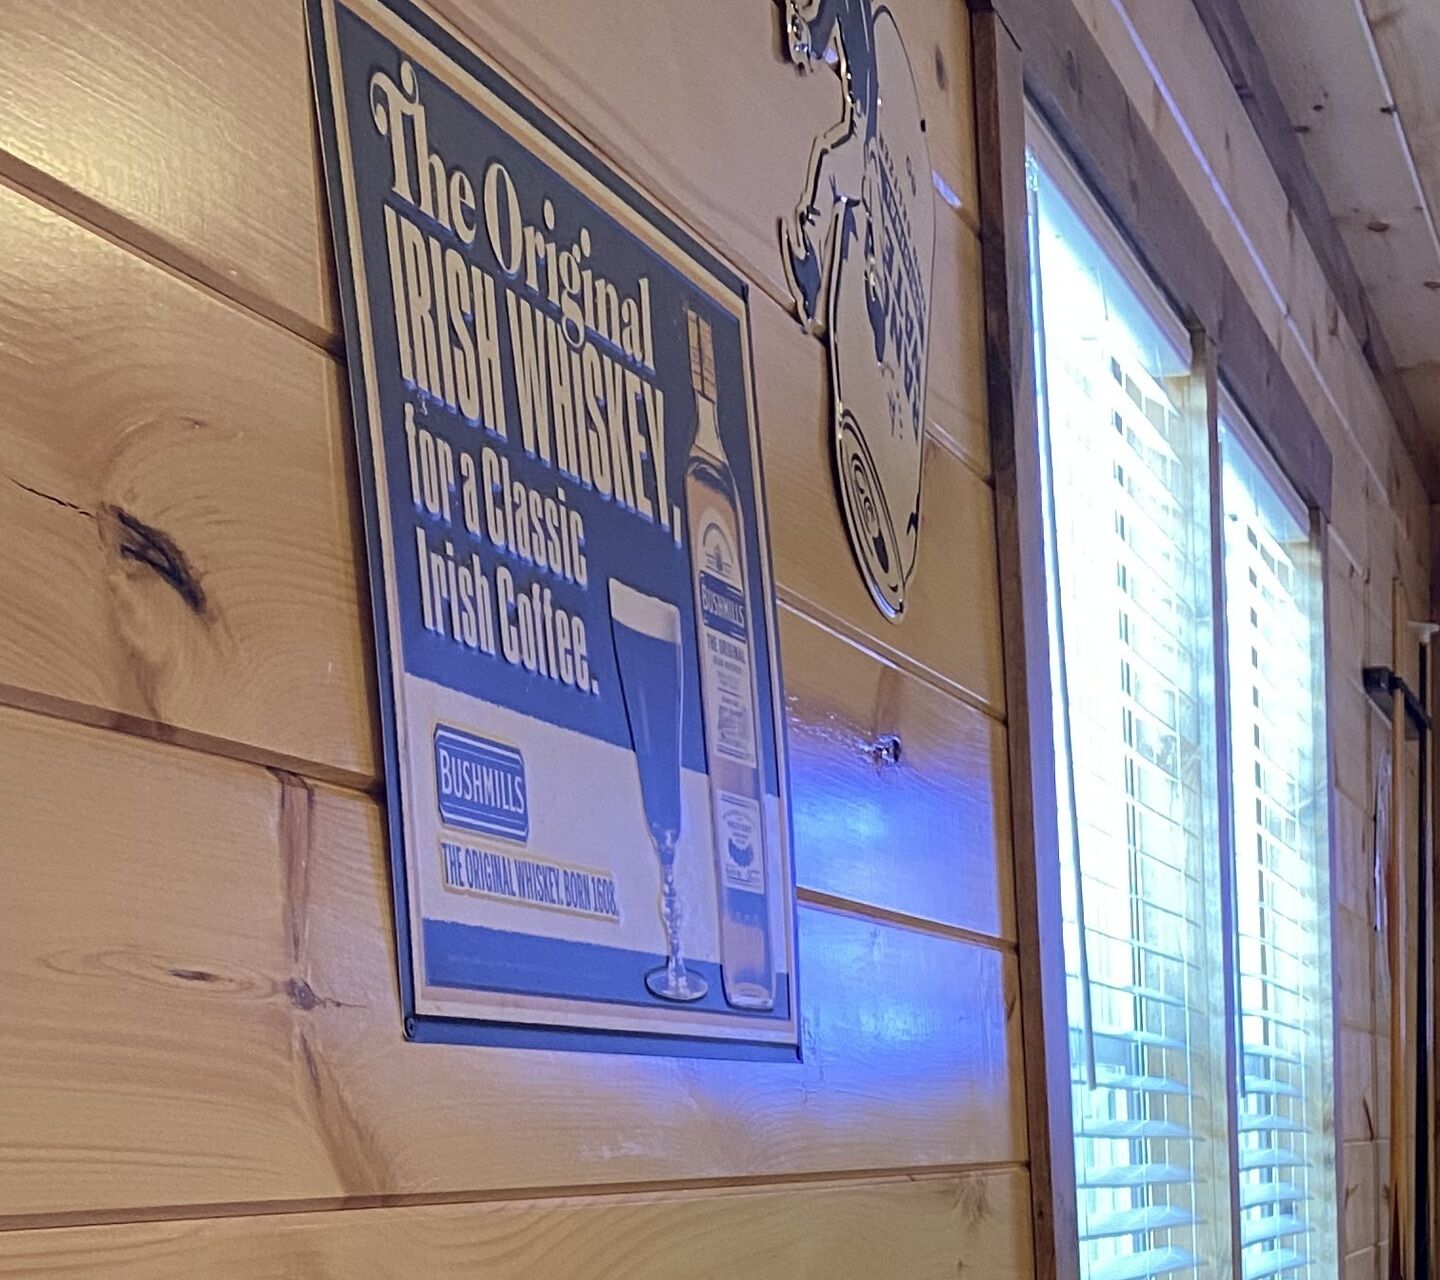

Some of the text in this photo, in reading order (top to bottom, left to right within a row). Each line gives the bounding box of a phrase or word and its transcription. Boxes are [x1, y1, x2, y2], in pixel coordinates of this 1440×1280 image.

[370, 60, 654, 369] The Original
[384, 204, 681, 548] IRISH WHISKEY,
[882, 224, 920, 398] WATE
[404, 402, 587, 588] for a Classic
[416, 526, 599, 695] Irish Coffee.
[702, 584, 745, 628] BUSHMILLS
[439, 748, 524, 814] BUSHMILLS
[442, 842, 463, 886] THE
[465, 848, 516, 895] ORIGINAL
[563, 869, 592, 910] BORN
